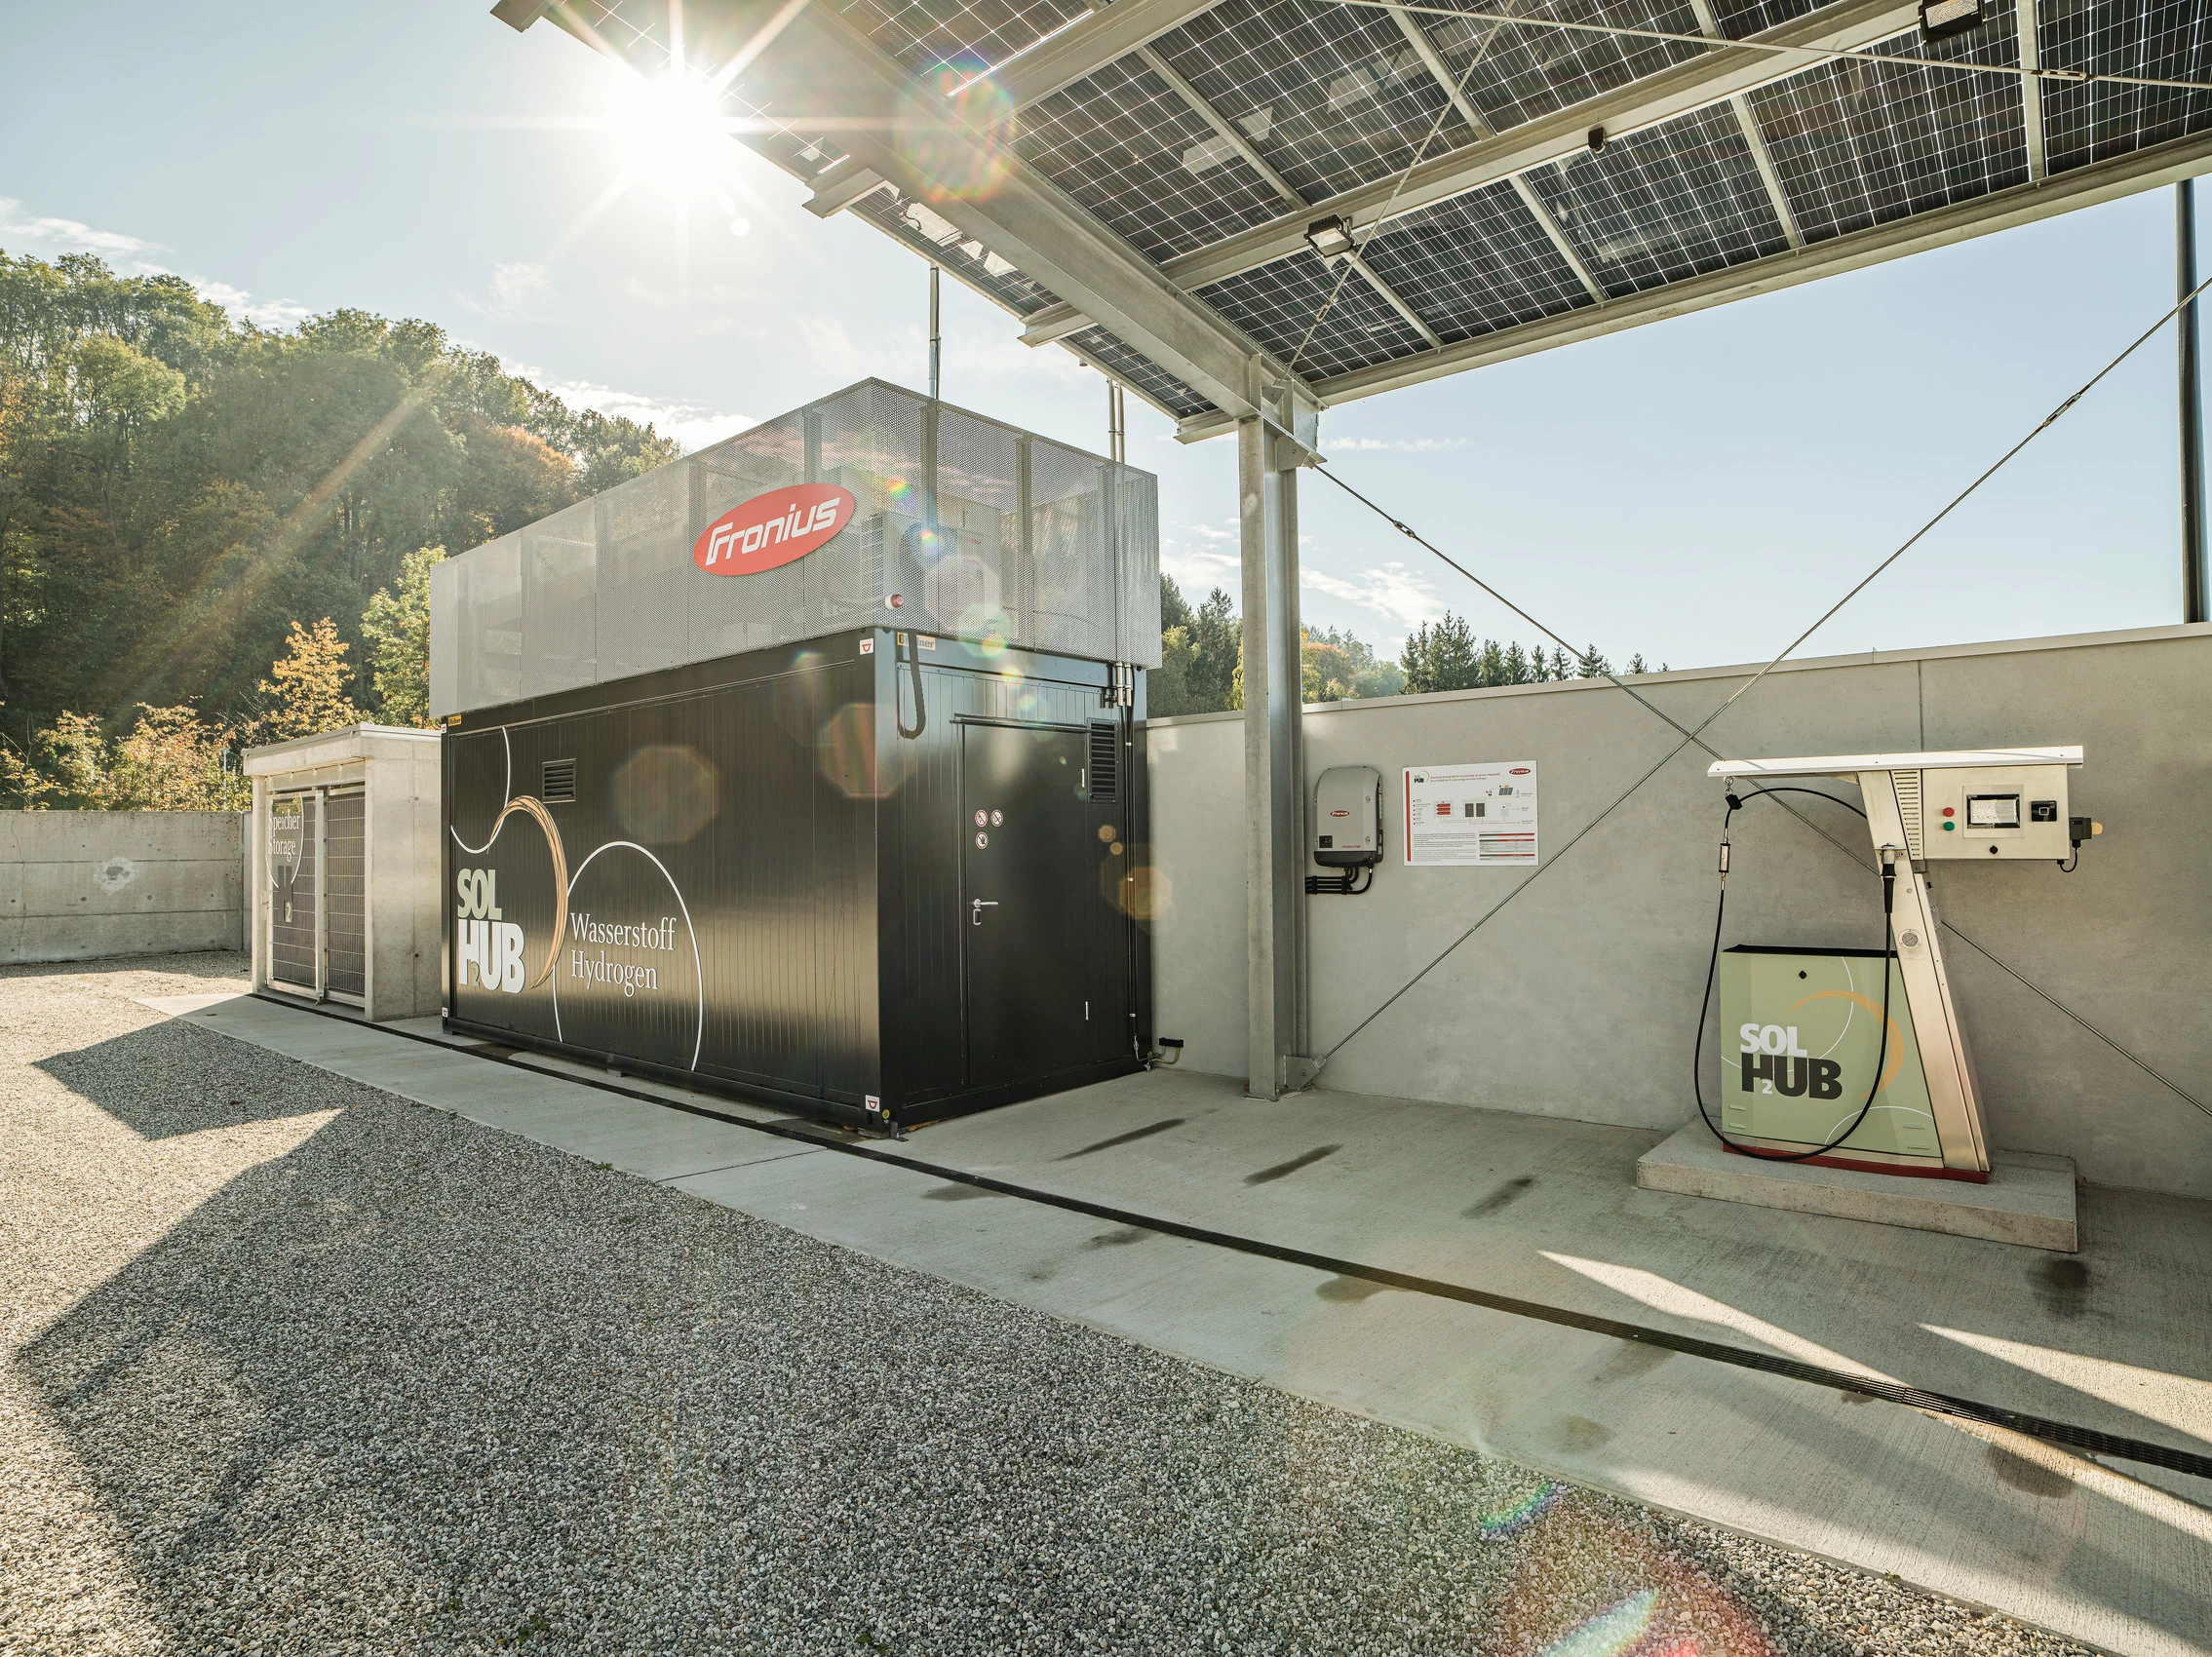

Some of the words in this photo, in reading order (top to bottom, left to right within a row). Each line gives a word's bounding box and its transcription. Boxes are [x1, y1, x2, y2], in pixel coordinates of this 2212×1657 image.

[705, 497, 841, 566] Fronius
[268, 808, 301, 836] Speicher
[268, 835, 296, 863] Storage
[457, 868, 502, 921] SOL
[570, 912, 677, 951] Wasserstoff
[570, 949, 659, 997] Hydrogen
[1739, 1022, 1807, 1059] SOL
